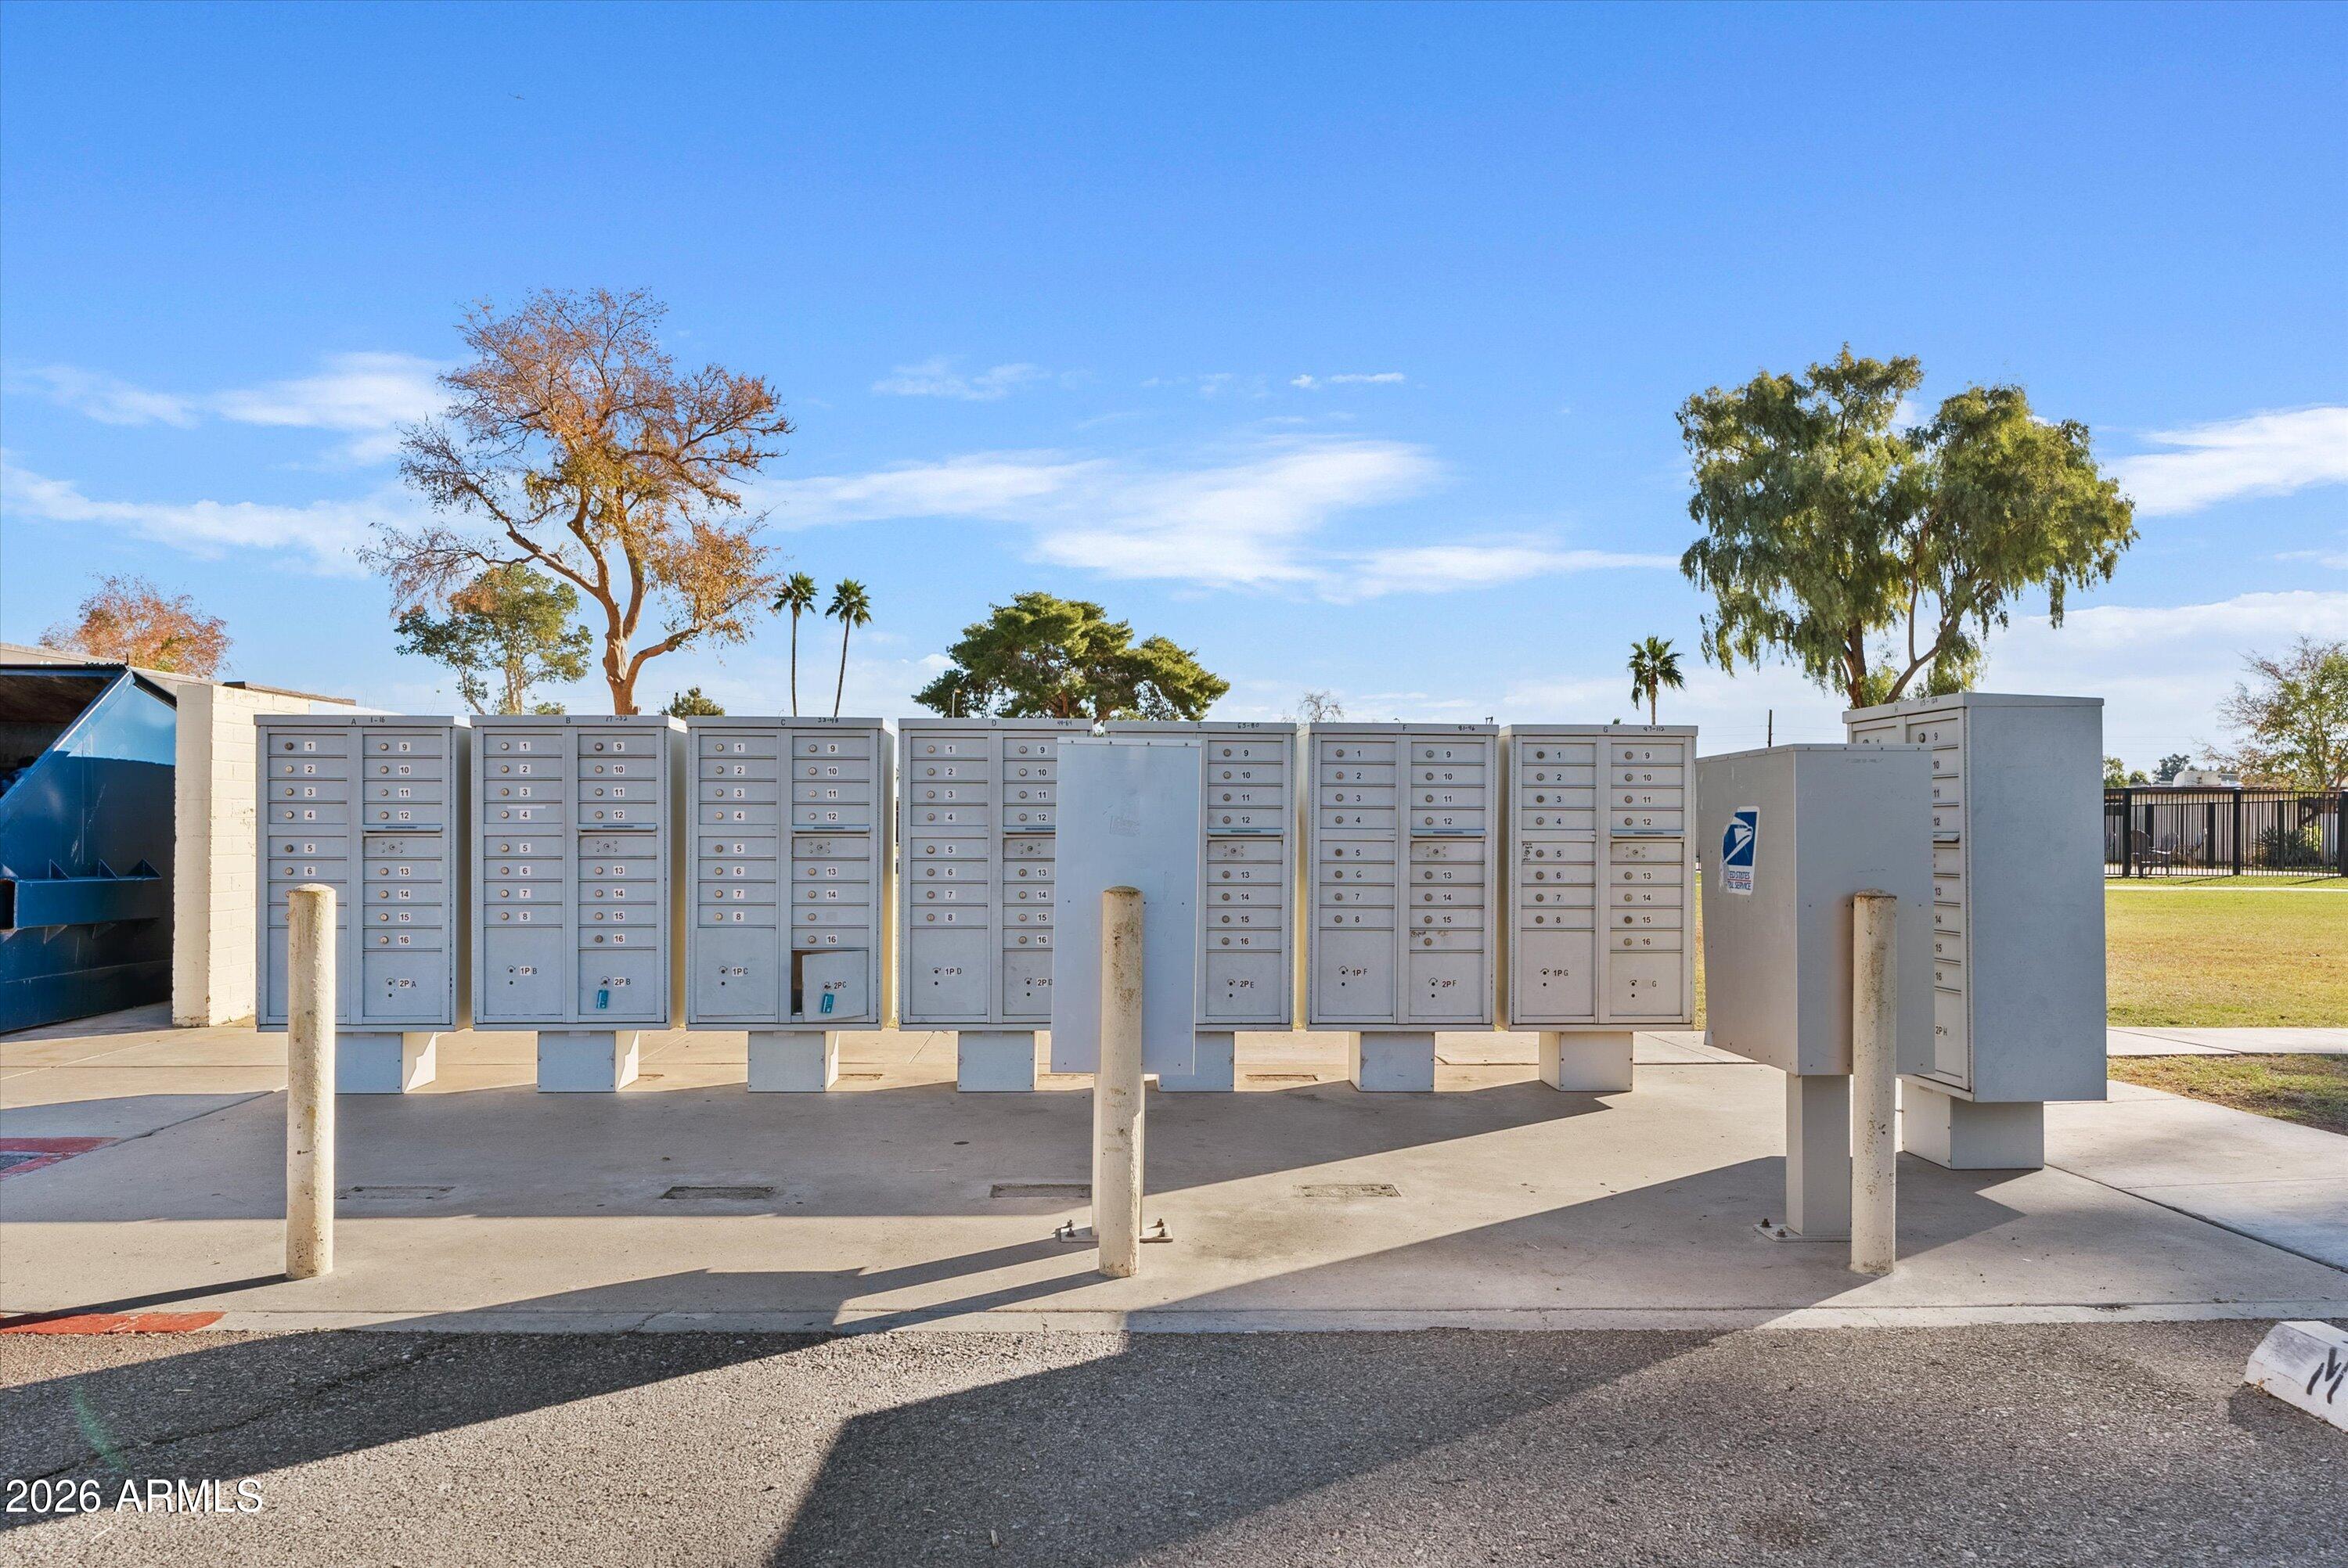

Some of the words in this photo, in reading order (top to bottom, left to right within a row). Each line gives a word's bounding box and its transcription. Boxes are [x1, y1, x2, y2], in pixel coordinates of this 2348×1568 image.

[565, 716, 571, 725] B
[1403, 724, 1407, 732] F
[1934, 732, 1939, 741] 9
[1932, 761, 1939, 770] 10
[1933, 789, 1939, 797] 11
[1933, 817, 1940, 826] 12
[1356, 870, 1362, 879] 6
[1735, 871, 1751, 880] STATES
[1734, 881, 1752, 890] SERVICE
[1935, 887, 1942, 896] 13
[1935, 915, 1942, 924] 14
[1936, 944, 1943, 953] 15
[1563, 969, 1568, 977] G
[1936, 972, 1943, 981] 16
[834, 981, 842, 990] 2P
[1936, 1026, 1943, 1035] 2P
[1943, 1027, 1948, 1036] H
